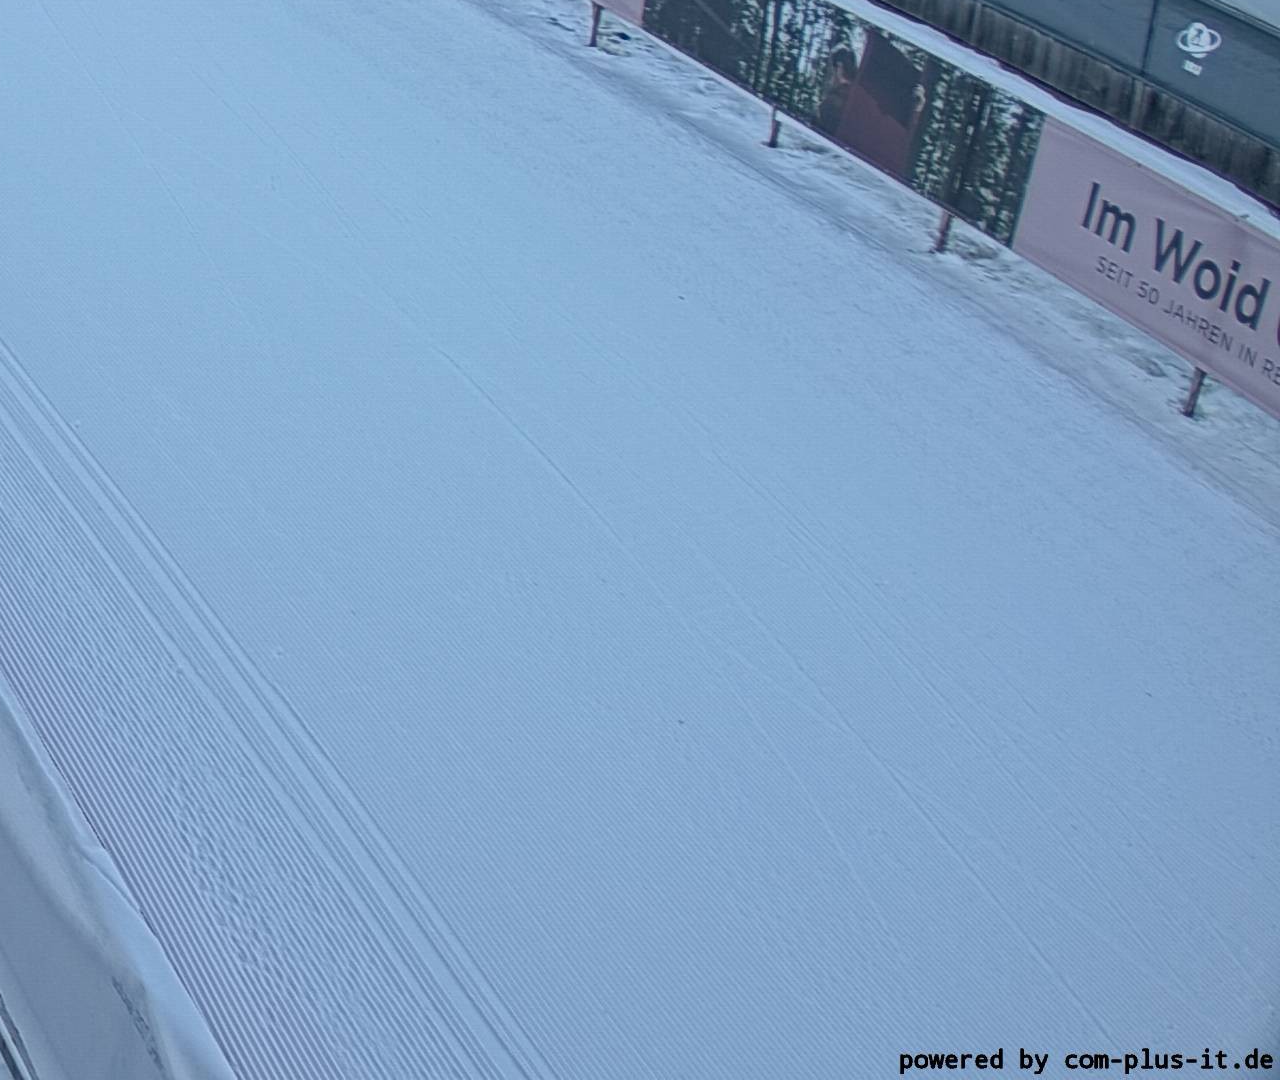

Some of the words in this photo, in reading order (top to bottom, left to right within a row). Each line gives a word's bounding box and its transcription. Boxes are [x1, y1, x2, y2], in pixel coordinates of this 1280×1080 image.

[1081, 181, 1137, 254] Im
[1153, 218, 1272, 332] Woid
[1096, 255, 1134, 289] SEIT
[1139, 280, 1160, 306] 50
[1162, 299, 1235, 352] JAHREN
[1238, 343, 1258, 369] IN
